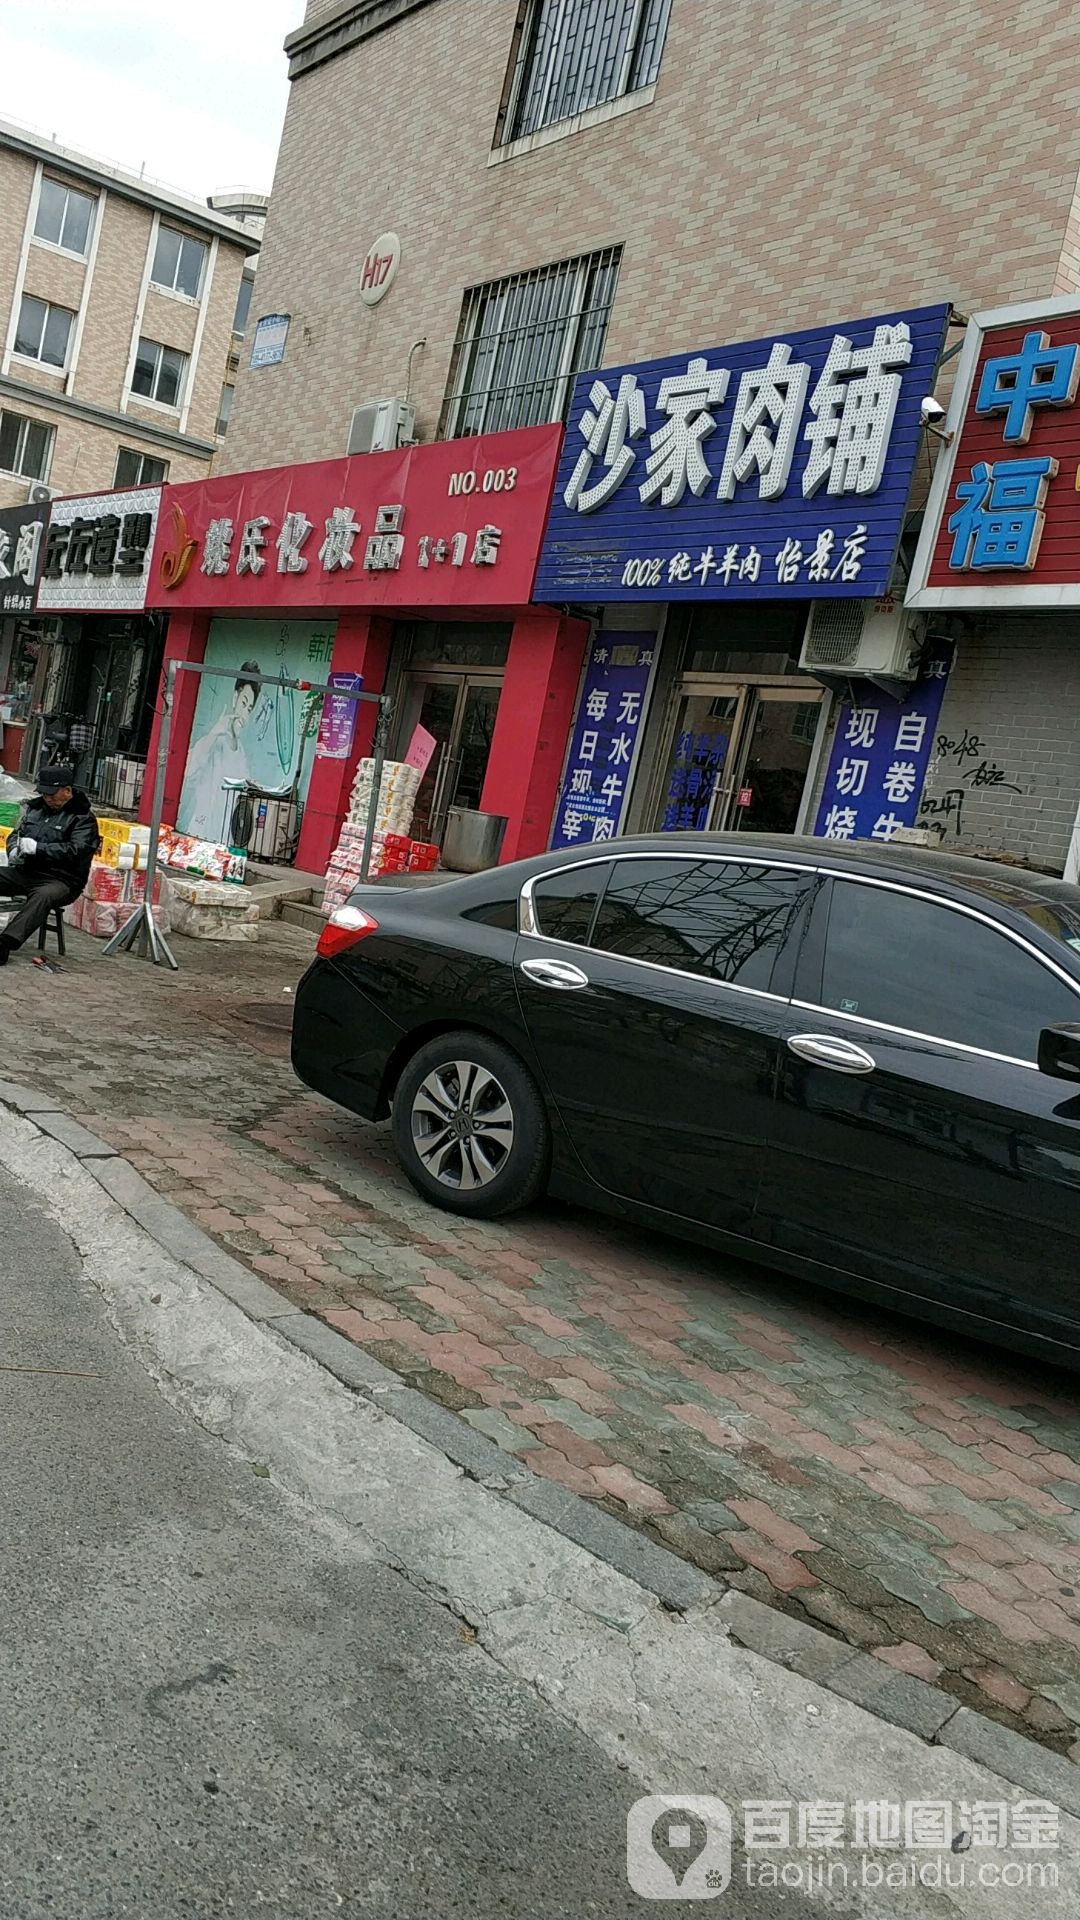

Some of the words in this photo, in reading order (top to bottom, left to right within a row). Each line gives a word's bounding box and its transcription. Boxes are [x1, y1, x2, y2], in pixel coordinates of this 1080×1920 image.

[361, 253, 394, 291] H17
[564, 322, 911, 513] 沙家肉铺
[975, 331, 1080, 445] 中
[448, 467, 518, 496] NO.003
[949, 456, 1059, 572] 福
[775, 524, 868, 584] 怡景店
[923, 660, 946, 679] 真
[592, 692, 642, 842] 无水牛肉
